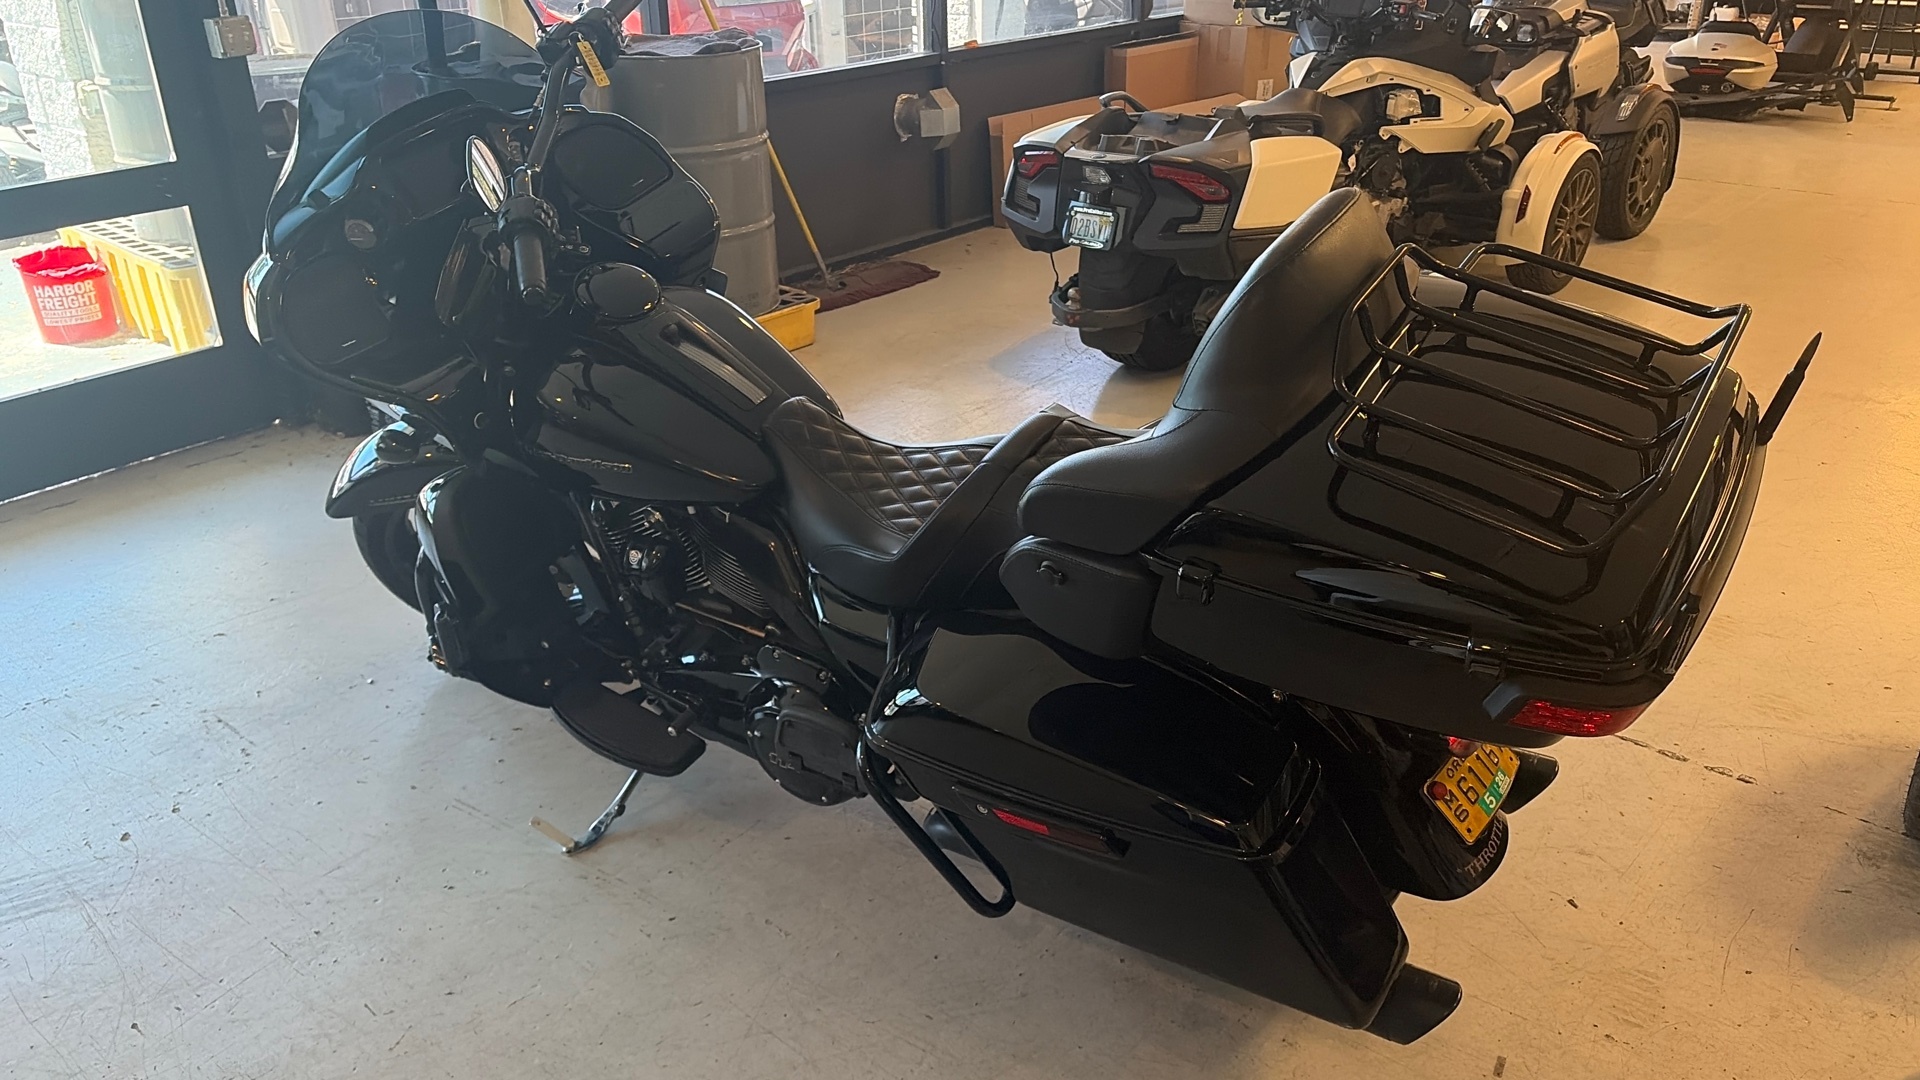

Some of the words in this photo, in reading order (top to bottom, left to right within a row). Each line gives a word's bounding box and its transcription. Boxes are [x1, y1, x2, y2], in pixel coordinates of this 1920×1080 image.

[33, 280, 95, 298] HARBOR
[37, 291, 97, 310] FREIGHT
[43, 309, 73, 317] QUALITY
[75, 305, 98, 314] TOOLS
[1456, 743, 1504, 806] 6116
[1483, 792, 1497, 809] 5
